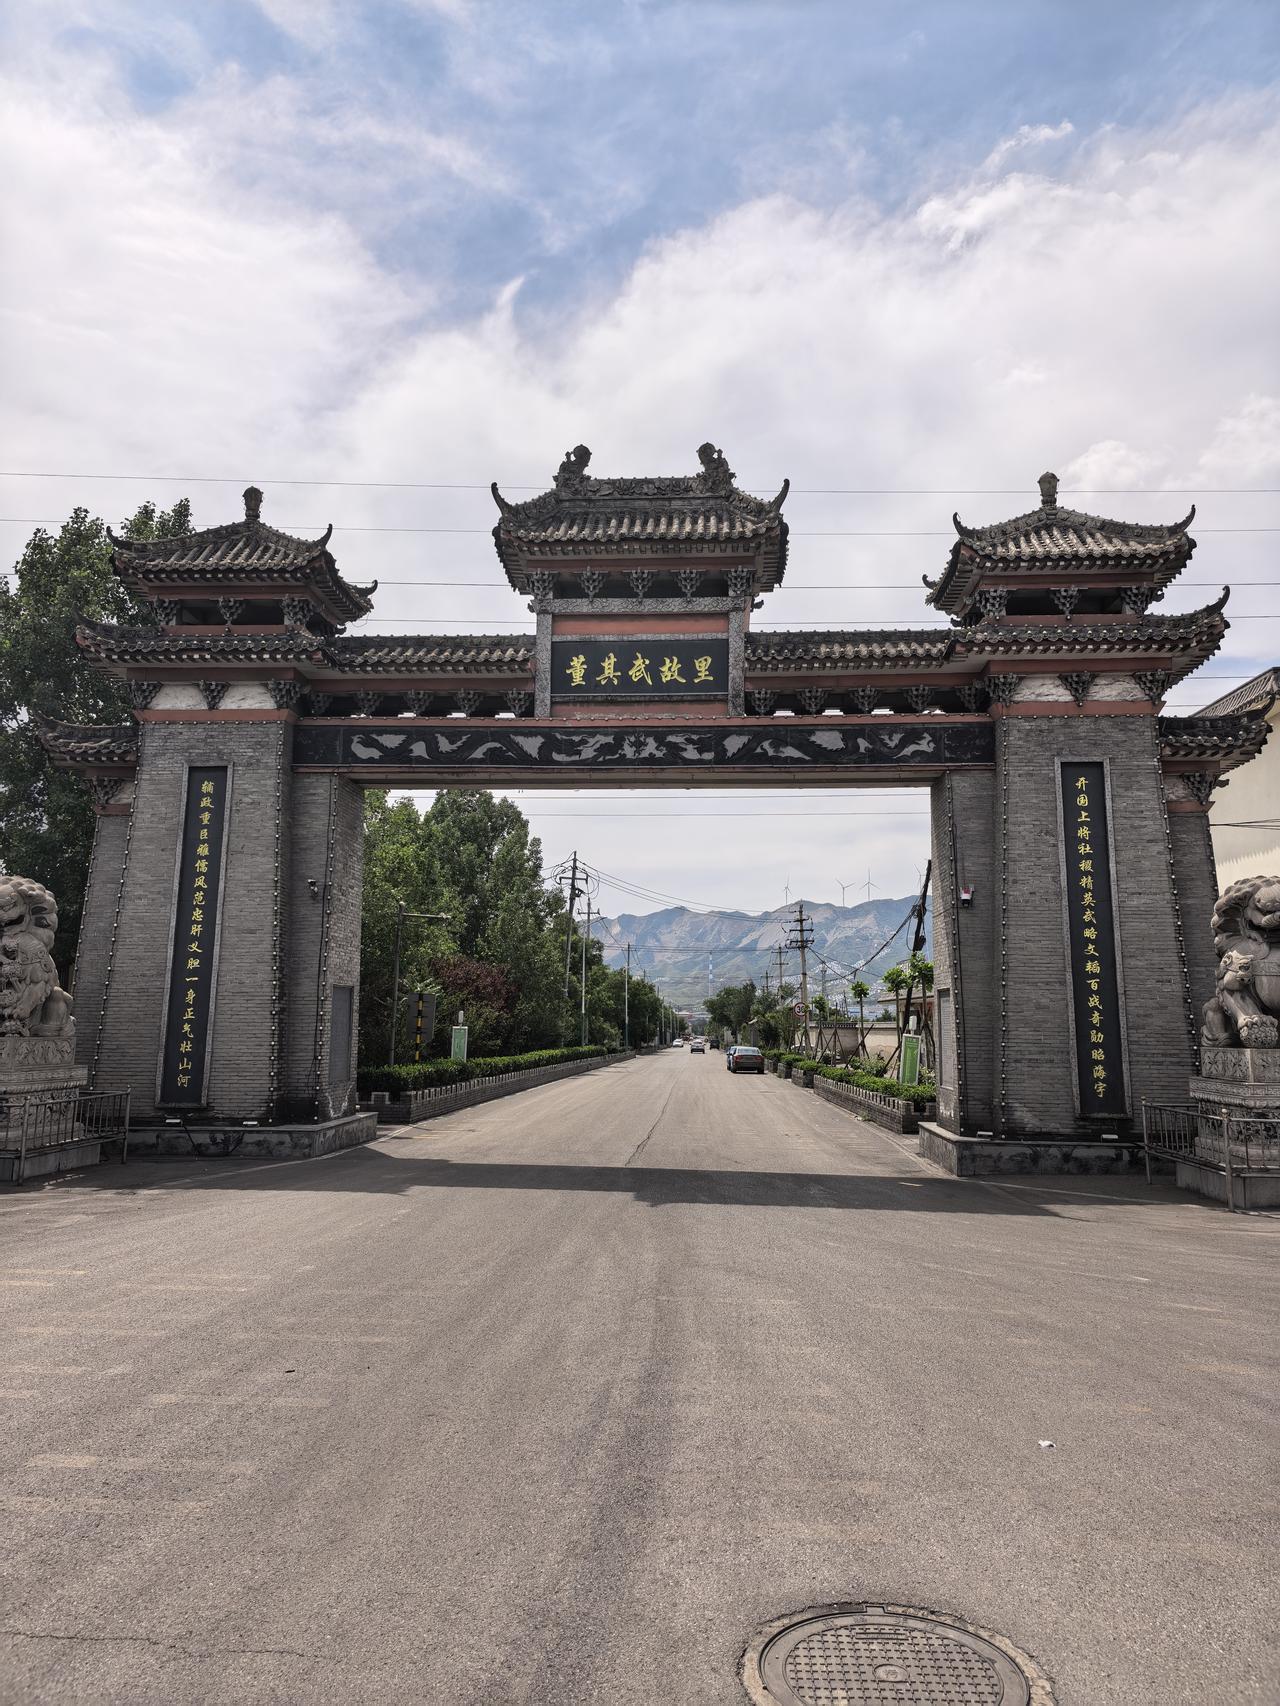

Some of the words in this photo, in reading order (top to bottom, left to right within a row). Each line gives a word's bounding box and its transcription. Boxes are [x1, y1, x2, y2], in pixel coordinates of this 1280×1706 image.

[566, 652, 714, 686] 董其武故里
